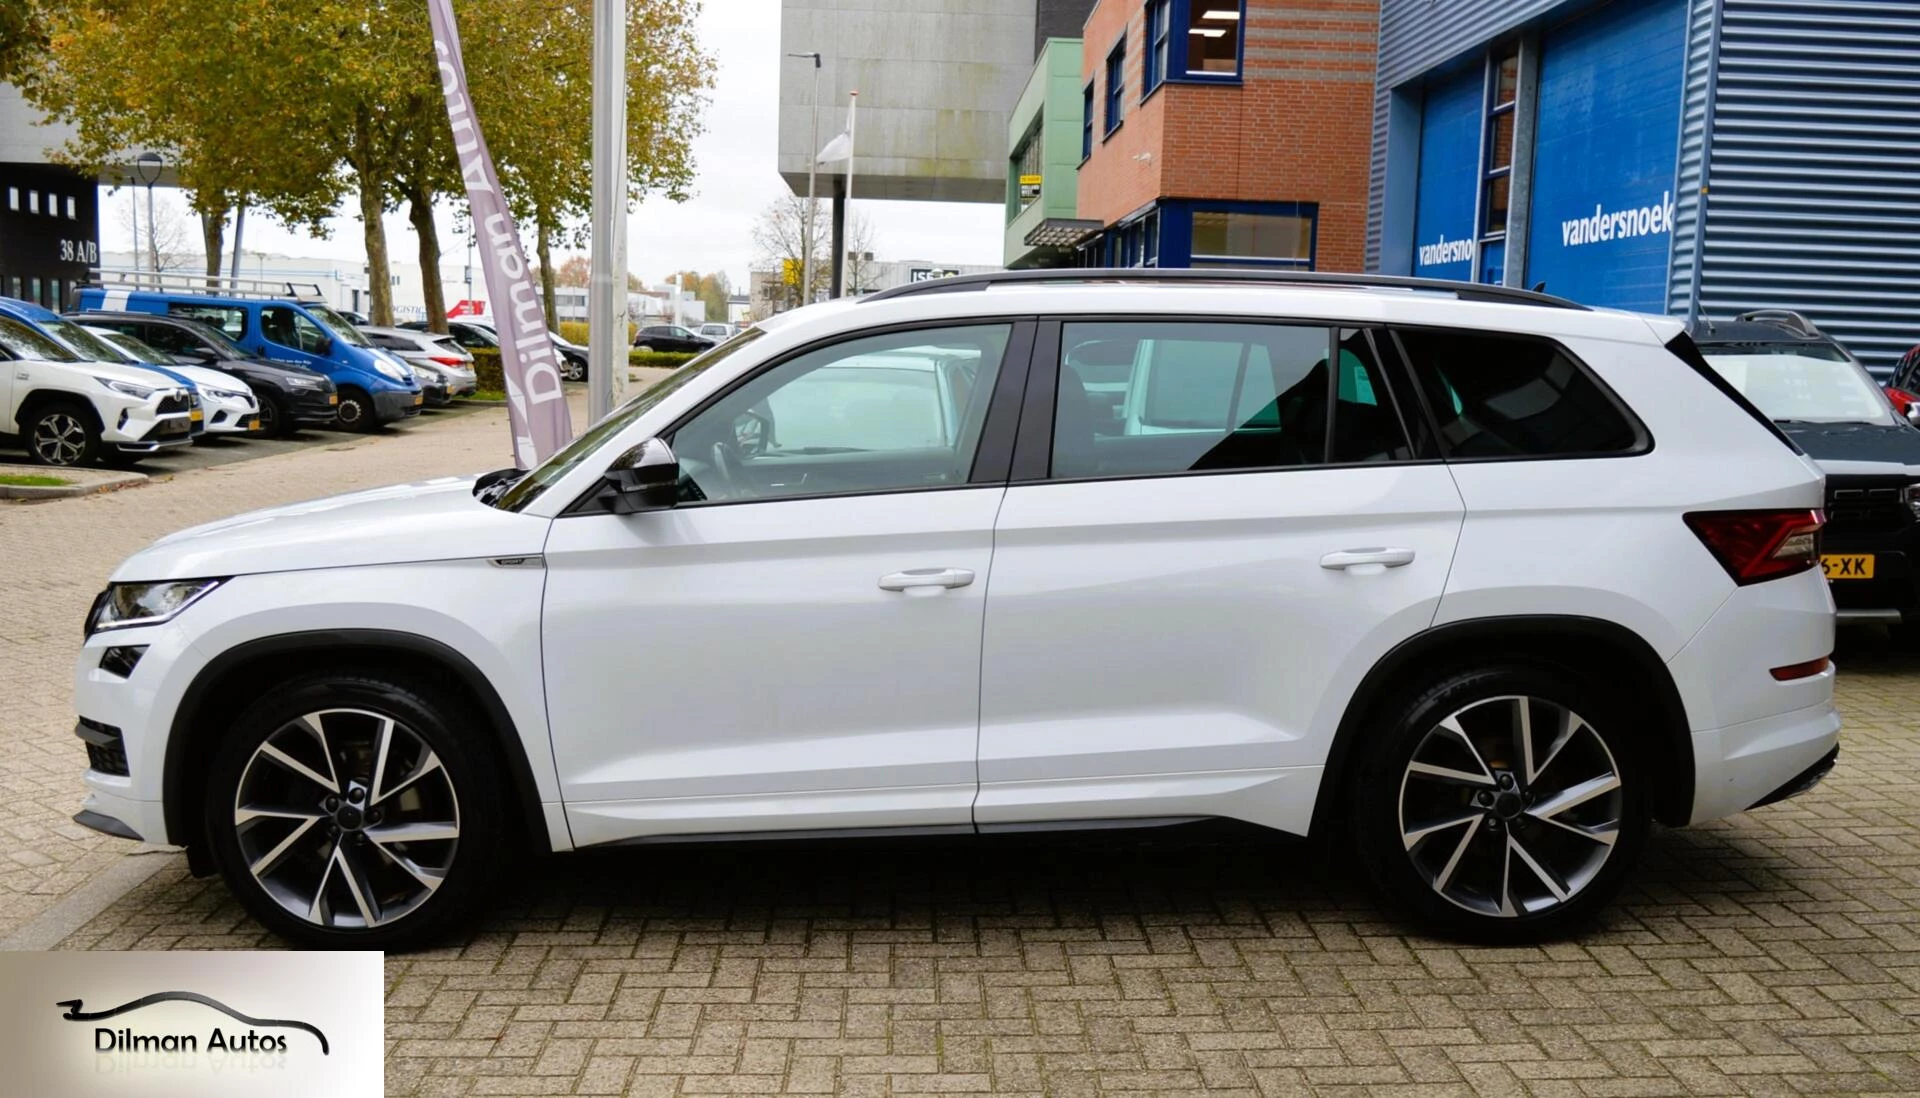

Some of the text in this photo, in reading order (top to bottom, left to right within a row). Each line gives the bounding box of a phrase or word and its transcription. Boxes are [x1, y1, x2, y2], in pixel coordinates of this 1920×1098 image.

[1562, 190, 1674, 247] vandersnoek
[60, 239, 98, 264] 38 A/B
[1419, 233, 1475, 266] vandersno
[485, 213, 563, 404] Dilman
